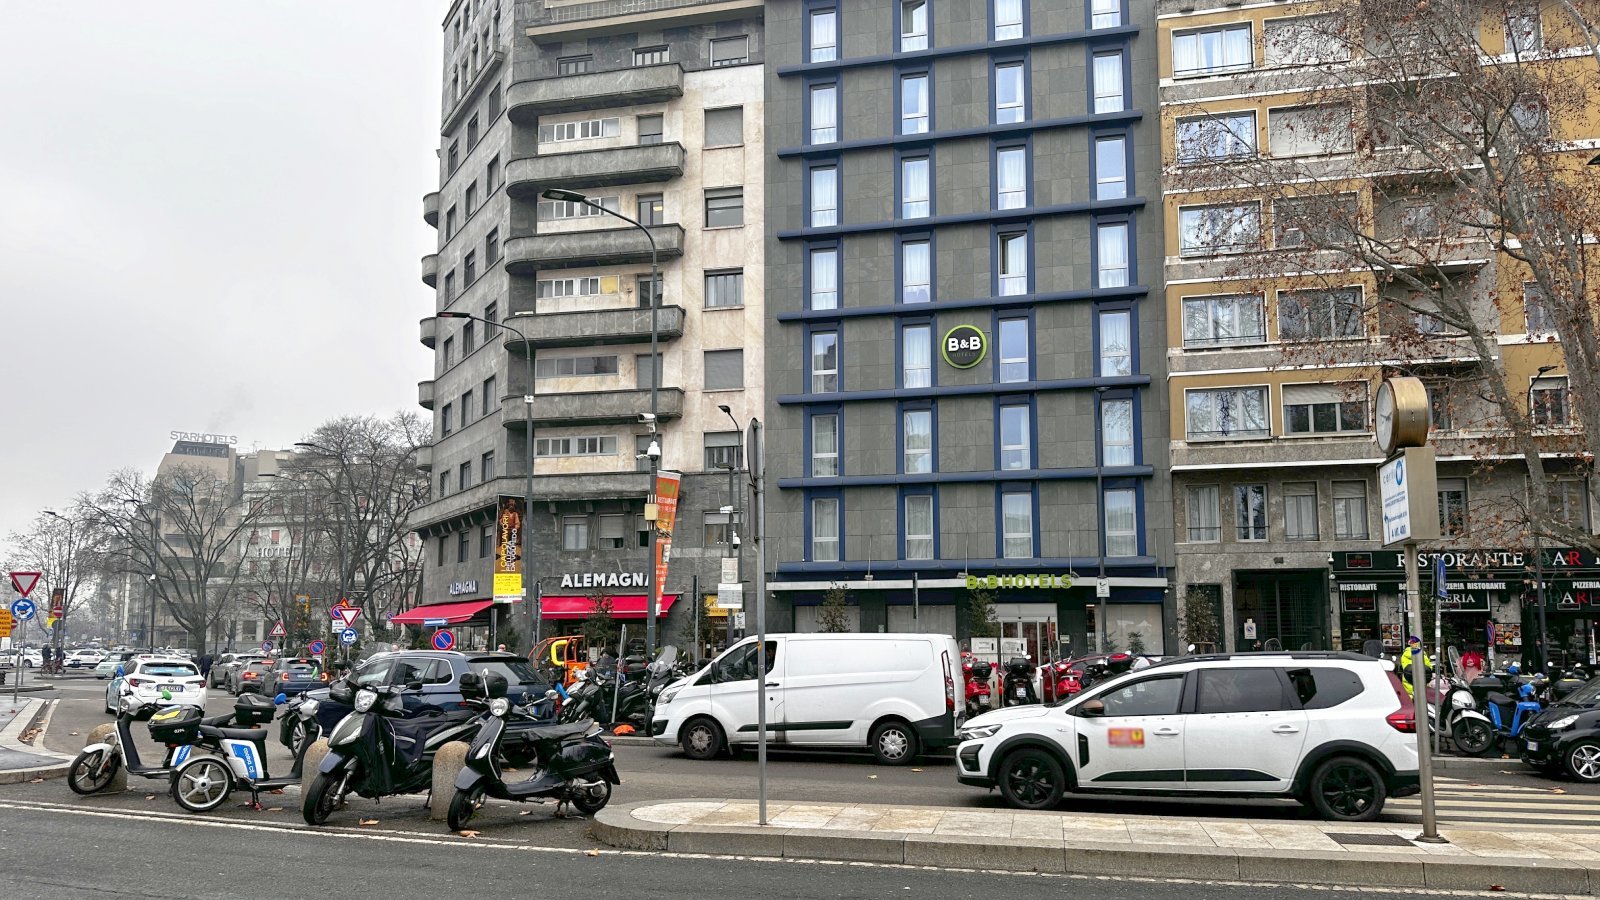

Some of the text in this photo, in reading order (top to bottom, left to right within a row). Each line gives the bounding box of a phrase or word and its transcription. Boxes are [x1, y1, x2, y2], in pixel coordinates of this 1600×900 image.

[948, 336, 981, 352] B&B
[170, 430, 238, 445] STARHOTELS
[1396, 552, 1524, 567] RSTORANTE
[450, 580, 476, 595] ALEMAGNA
[966, 573, 1072, 590] B&B HOTELS
[1339, 583, 1377, 591] RISTORANTE
[1467, 582, 1506, 590] RISTORANTE
